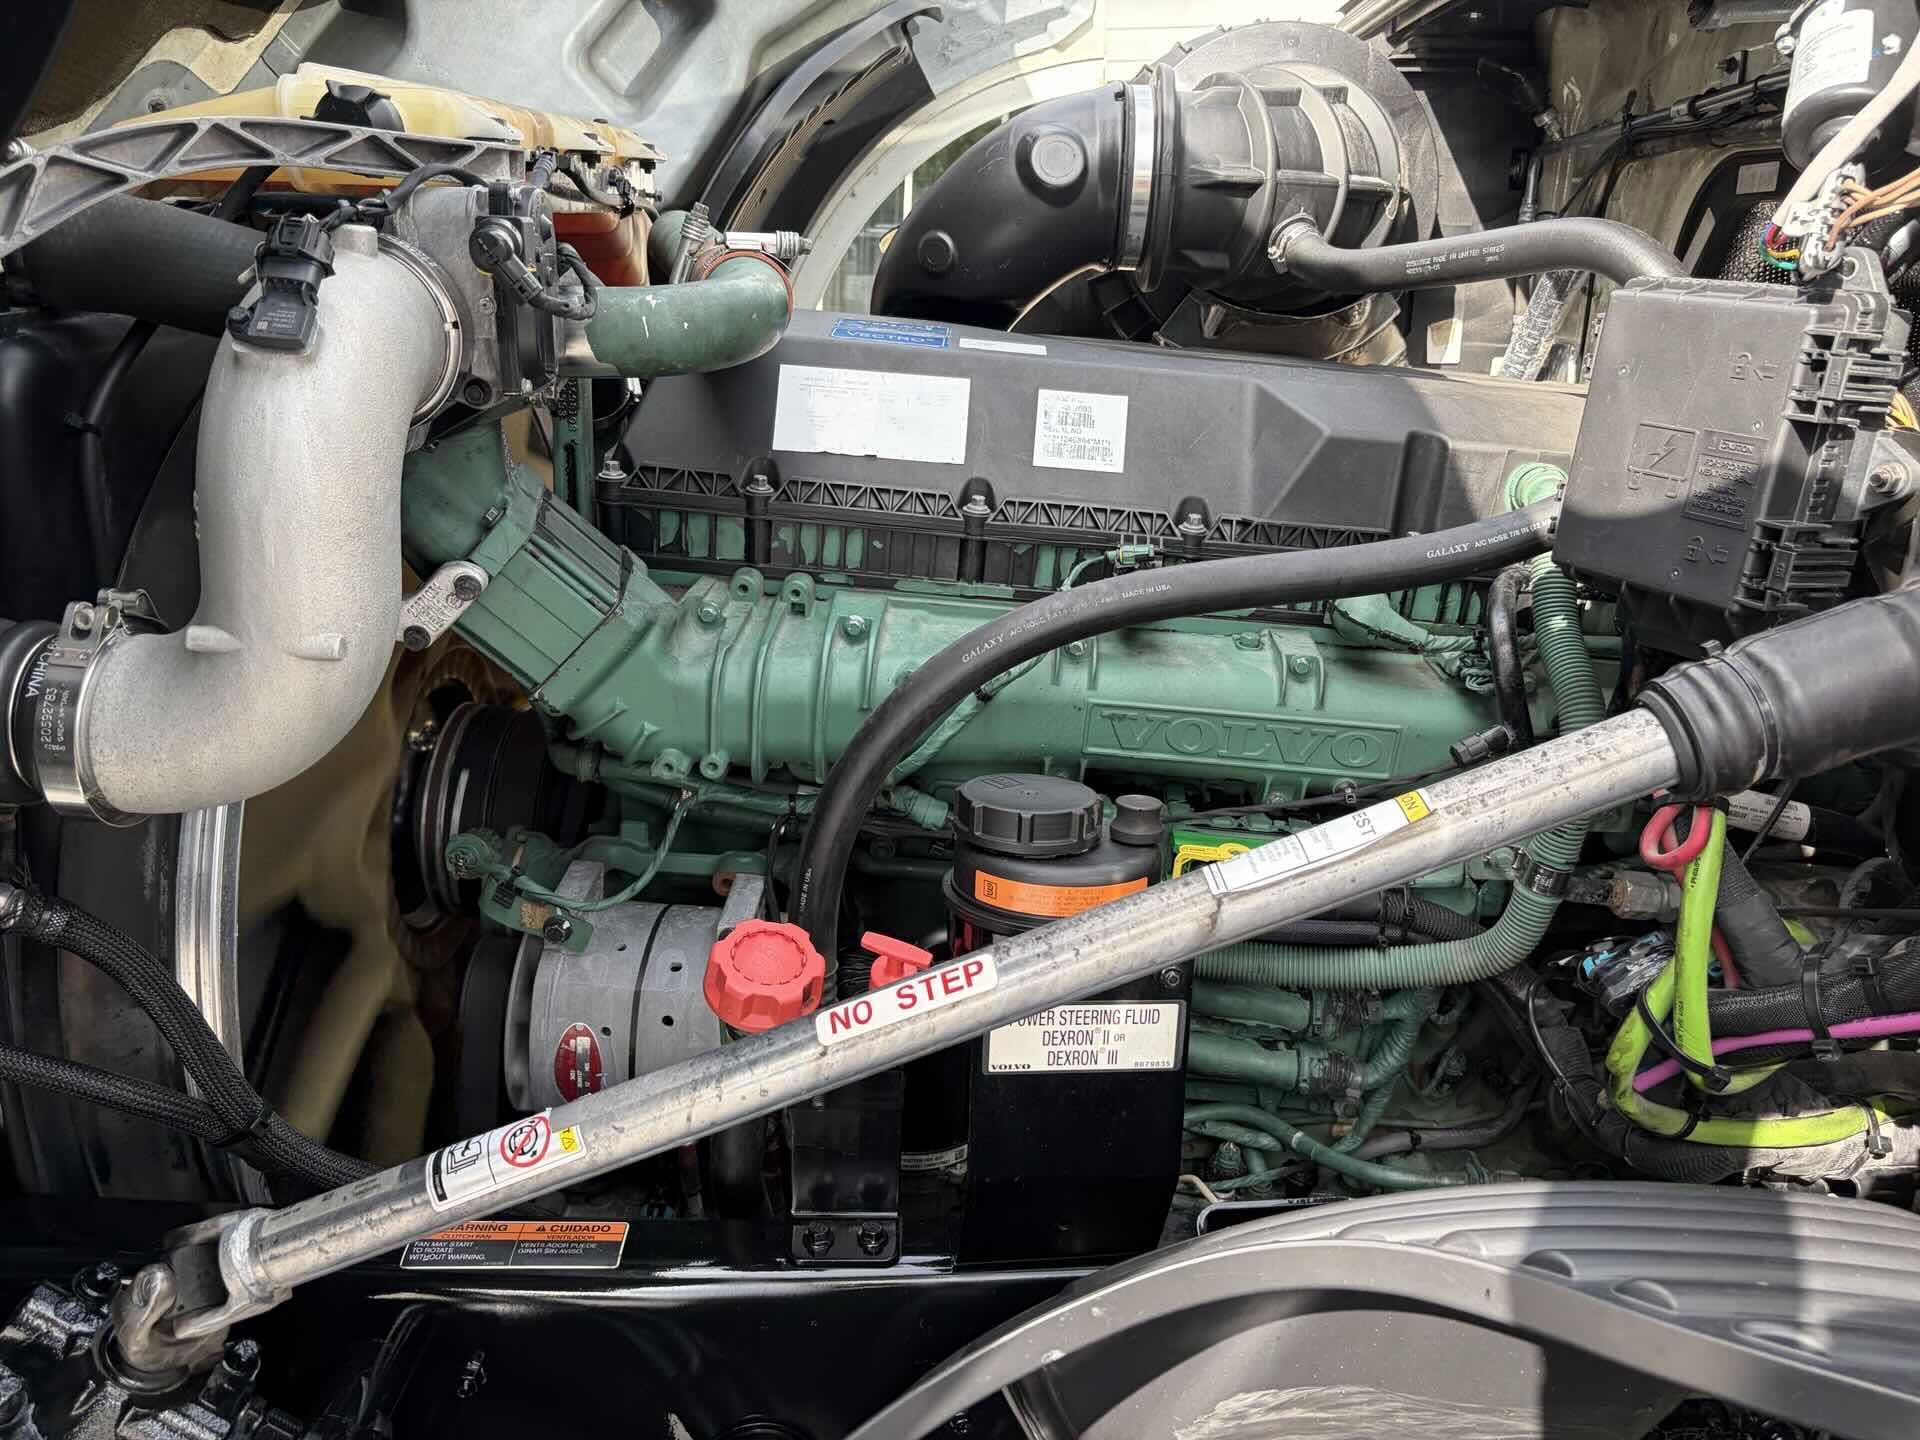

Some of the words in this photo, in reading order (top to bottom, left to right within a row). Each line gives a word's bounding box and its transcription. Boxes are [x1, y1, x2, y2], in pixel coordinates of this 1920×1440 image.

[1426, 541, 1468, 559] GALAXY
[1488, 533, 1510, 545] HOSE
[961, 634, 1004, 663] GALAXY
[41, 687, 58, 743] 20592783
[1100, 709, 1385, 768] VOLVO
[829, 999, 873, 1035] NO
[895, 959, 984, 1010] STEP
[1008, 1009, 1055, 1027] OWER
[1059, 1008, 1121, 1027] STEERING
[1125, 1008, 1161, 1025] FLUID
[1113, 1033, 1126, 1042] OR
[1107, 1049, 1119, 1065] III
[448, 1223, 509, 1232] ARNING
[550, 1224, 612, 1233] CUIDADO
[409, 1253, 447, 1261] WITHOUT
